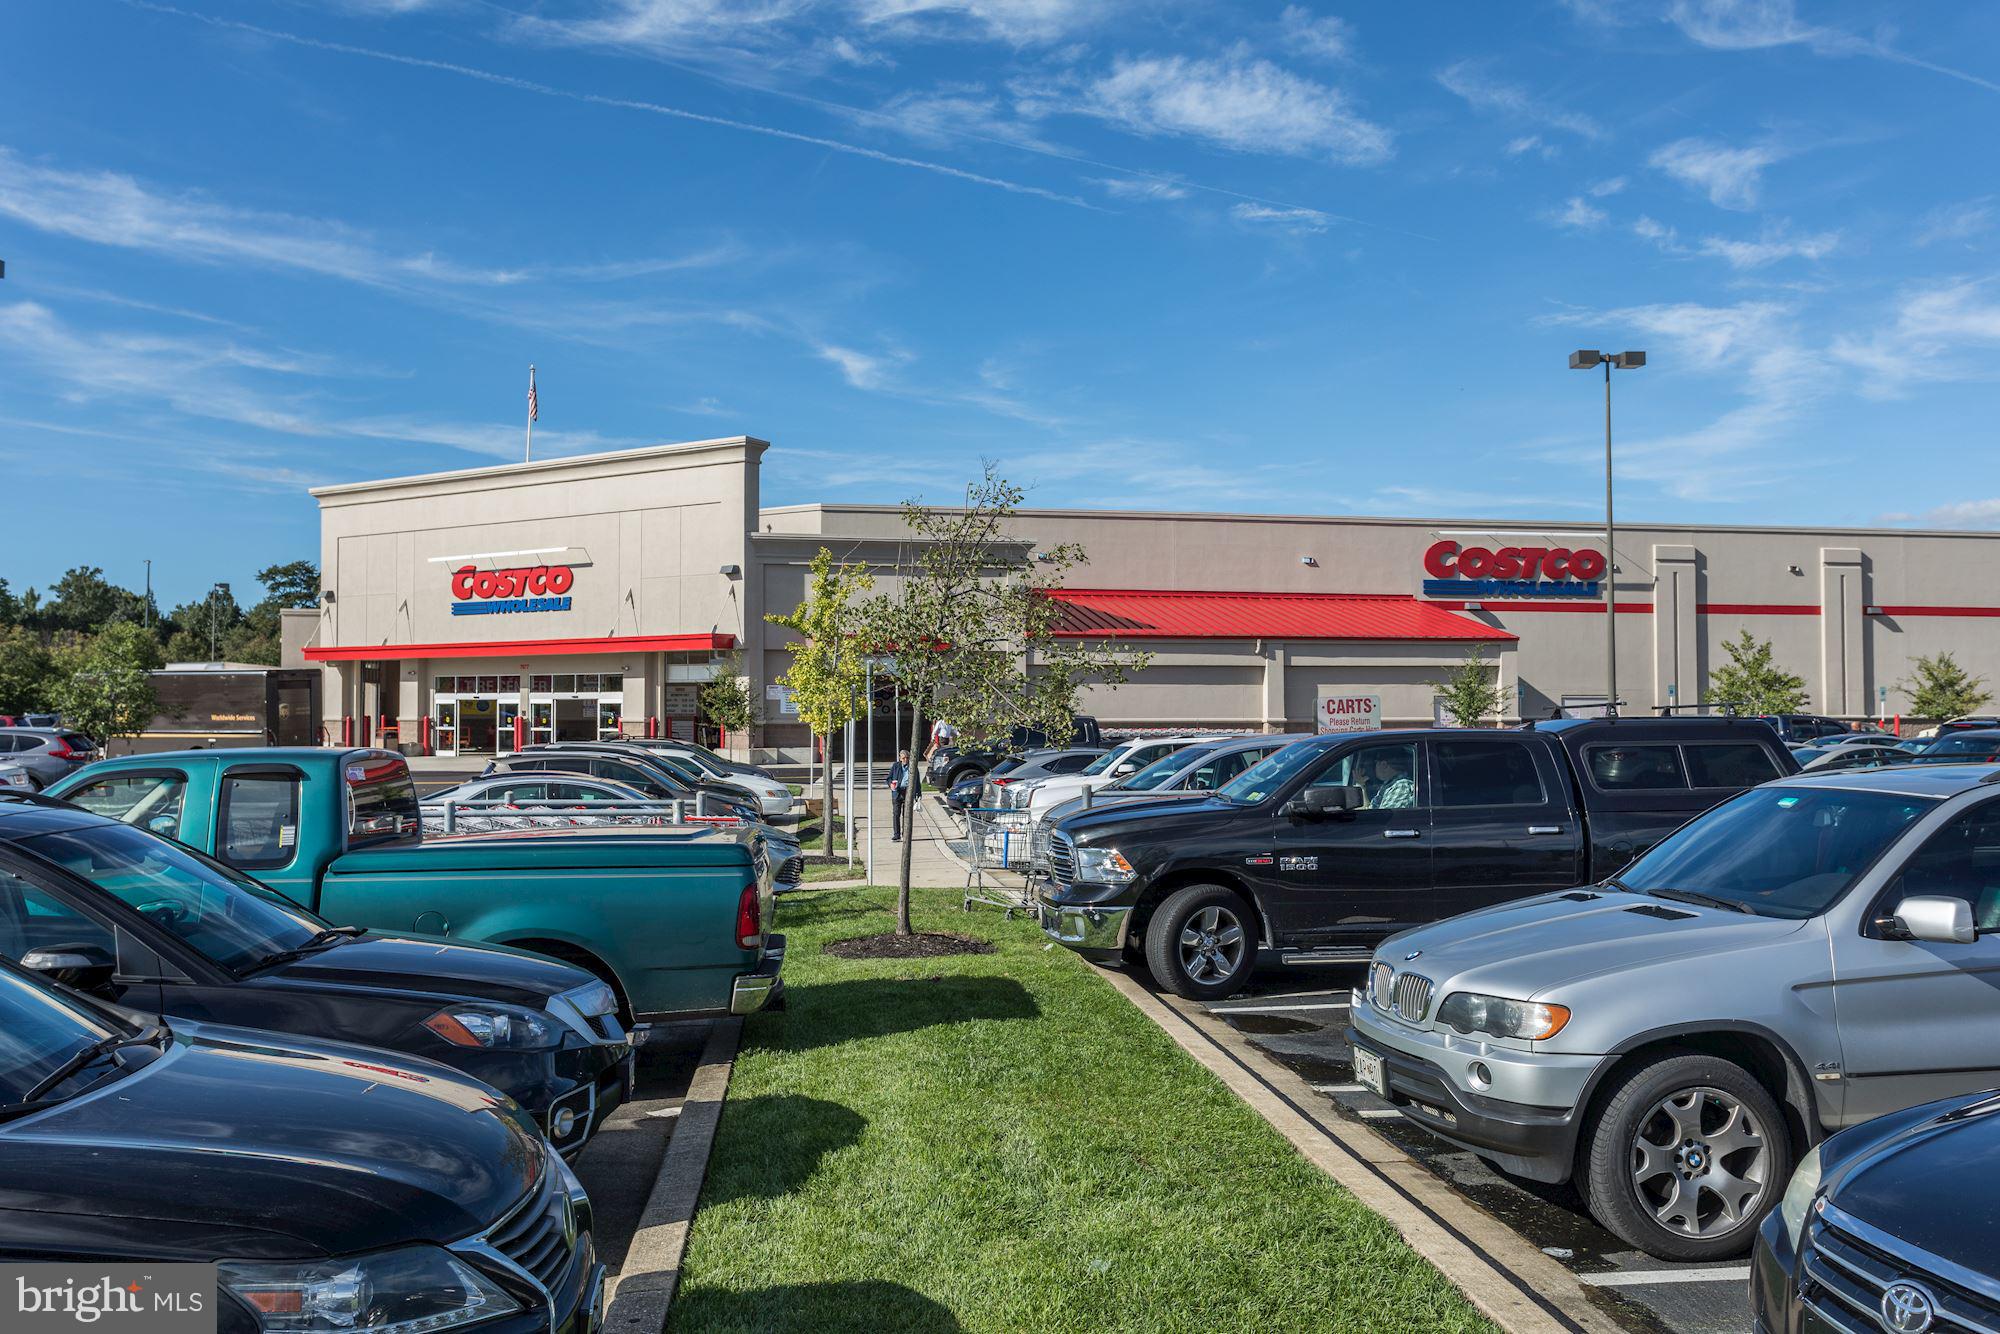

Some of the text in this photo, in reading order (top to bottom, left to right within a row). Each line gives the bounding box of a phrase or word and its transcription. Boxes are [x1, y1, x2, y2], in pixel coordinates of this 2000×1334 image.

[1424, 540, 1606, 580] COSTCO
[451, 565, 574, 600] COSTCO
[1477, 580, 1600, 597] WHOLESALE
[487, 597, 572, 614] WHOLESALE
[500, 680, 548, 691] CENER
[1327, 698, 1372, 714] CARTS
[1329, 717, 1371, 726] Please Return
